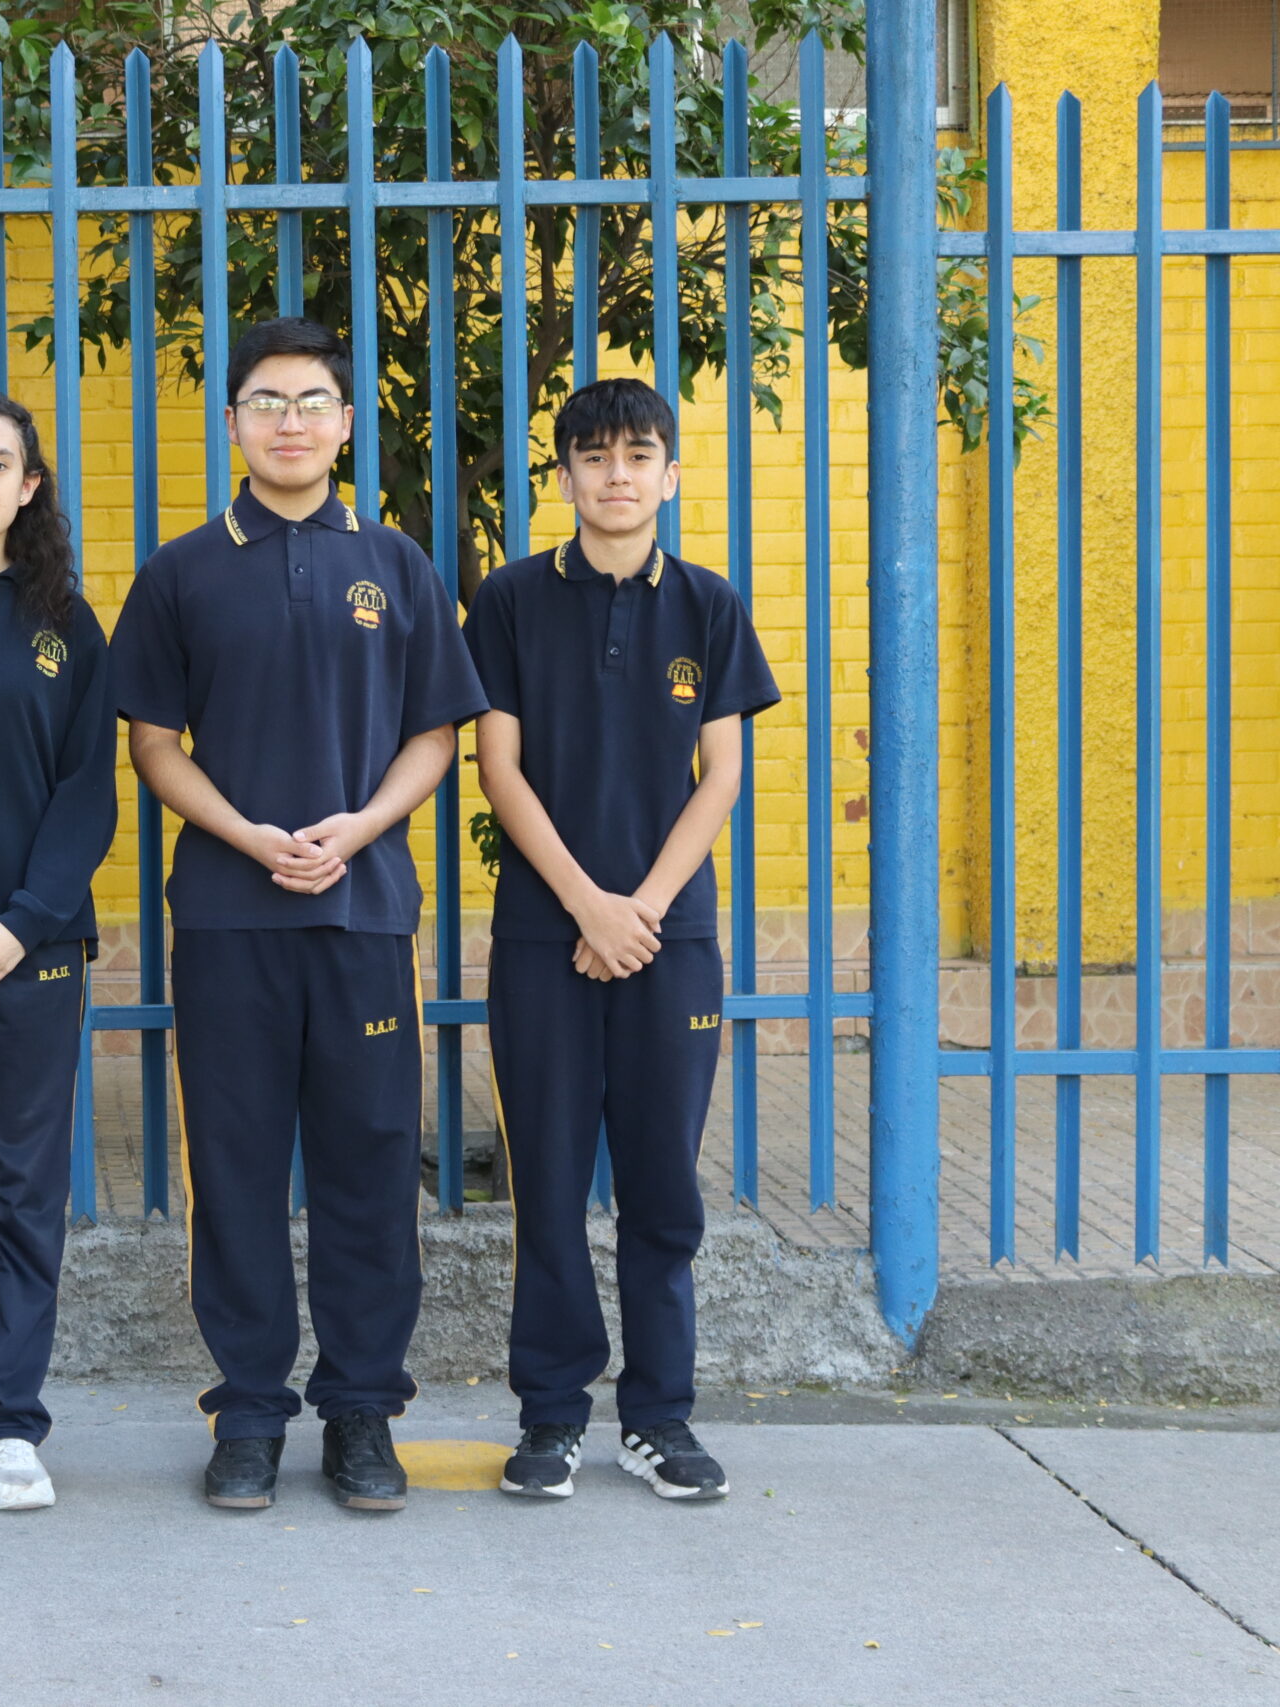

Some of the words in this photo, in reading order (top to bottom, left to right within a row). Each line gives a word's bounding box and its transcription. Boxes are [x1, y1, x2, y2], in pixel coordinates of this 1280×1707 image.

[673, 670, 696, 685] B.A.U.
[39, 965, 71, 981] B.A.U.
[365, 1017, 399, 1036] B.A.U.
